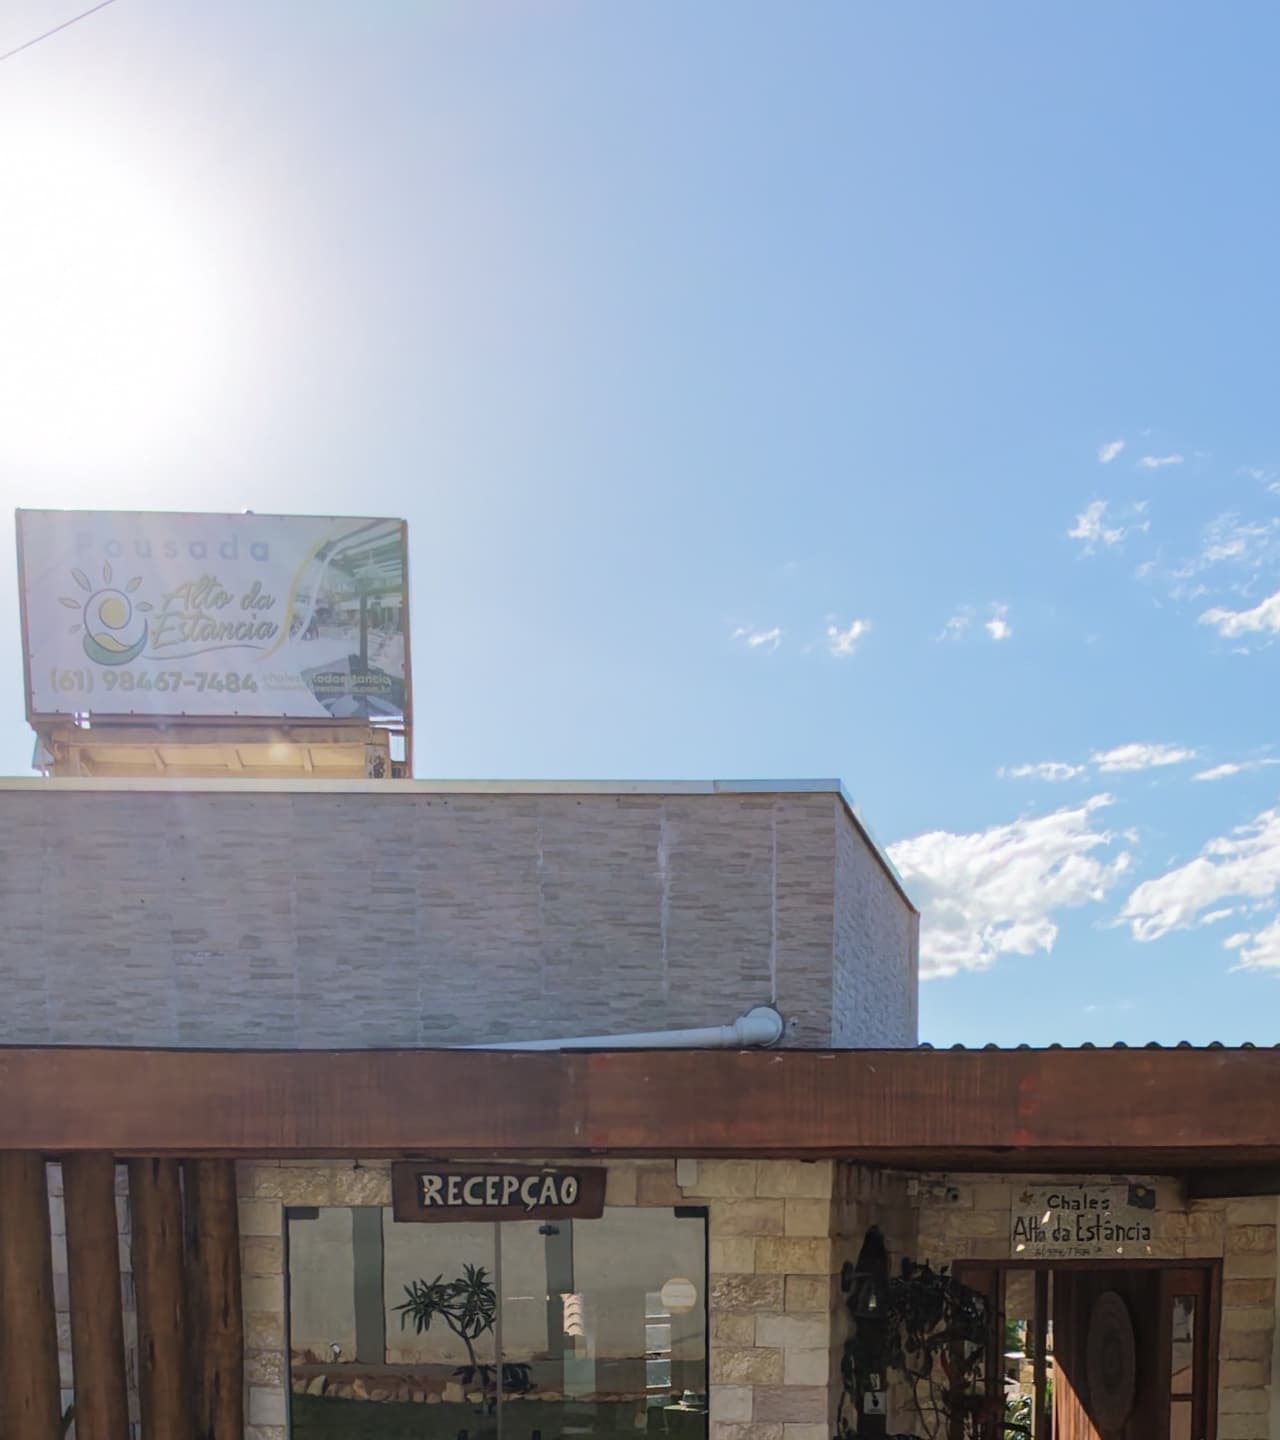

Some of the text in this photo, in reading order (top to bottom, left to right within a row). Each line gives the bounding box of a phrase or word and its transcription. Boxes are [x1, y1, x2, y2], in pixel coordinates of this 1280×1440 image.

[75, 533, 270, 562] Pousada
[160, 573, 276, 612] Alto da
[50, 667, 259, 694] (61) 98467-7484
[422, 1167, 579, 1212] RECEPÇÃO
[1051, 1214, 1071, 1242] da
[1075, 1213, 1152, 1243] Estância
